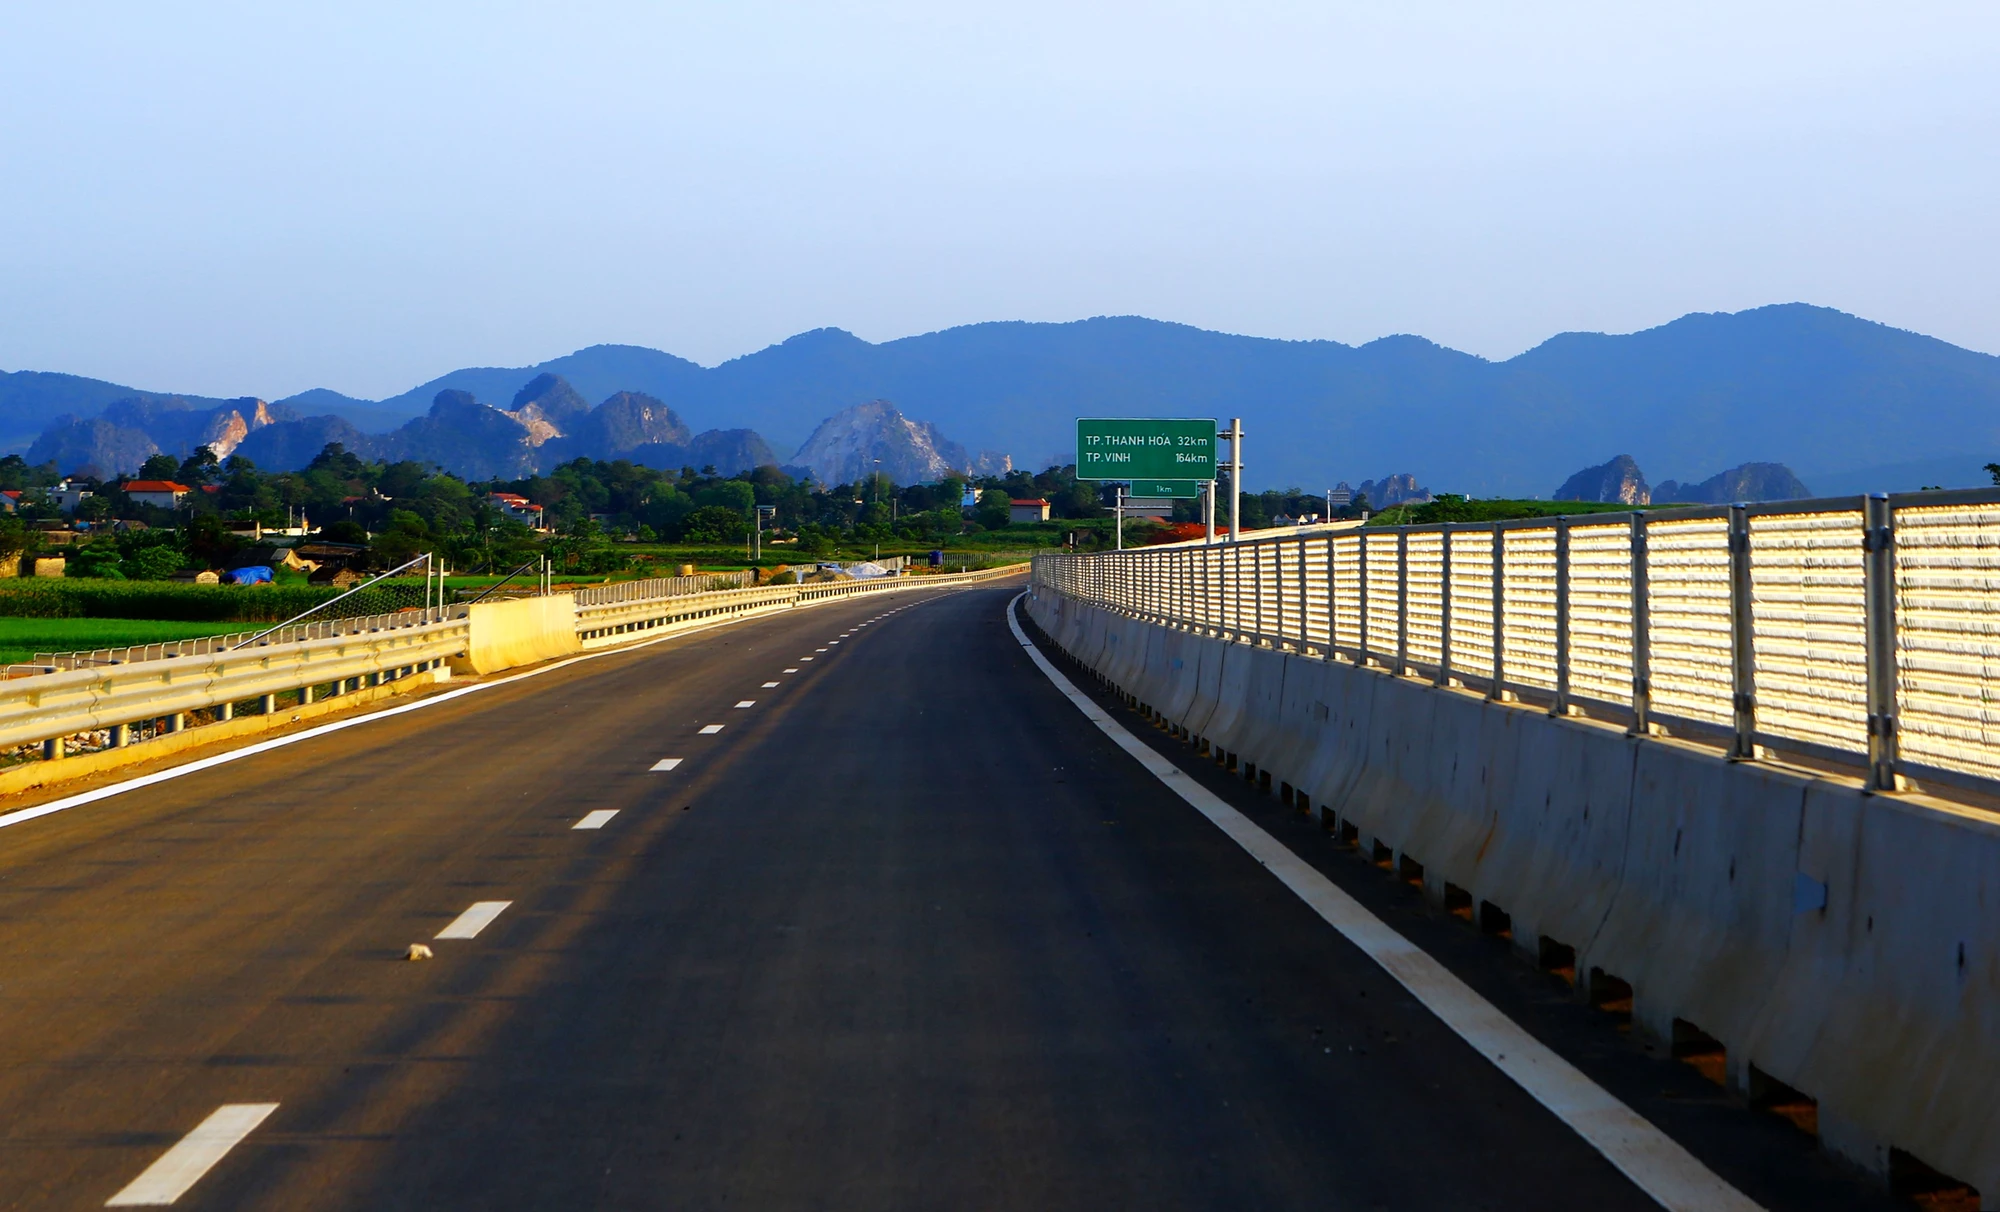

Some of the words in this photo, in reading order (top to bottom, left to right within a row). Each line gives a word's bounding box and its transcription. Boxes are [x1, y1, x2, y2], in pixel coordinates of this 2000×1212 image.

[1086, 435, 1145, 446] TP.THANH
[1148, 432, 1172, 446] HÓA
[1177, 435, 1208, 446] 32km
[1086, 452, 1131, 463] TP.VINH
[1176, 452, 1208, 463] 164km
[1156, 485, 1172, 493] 1km
